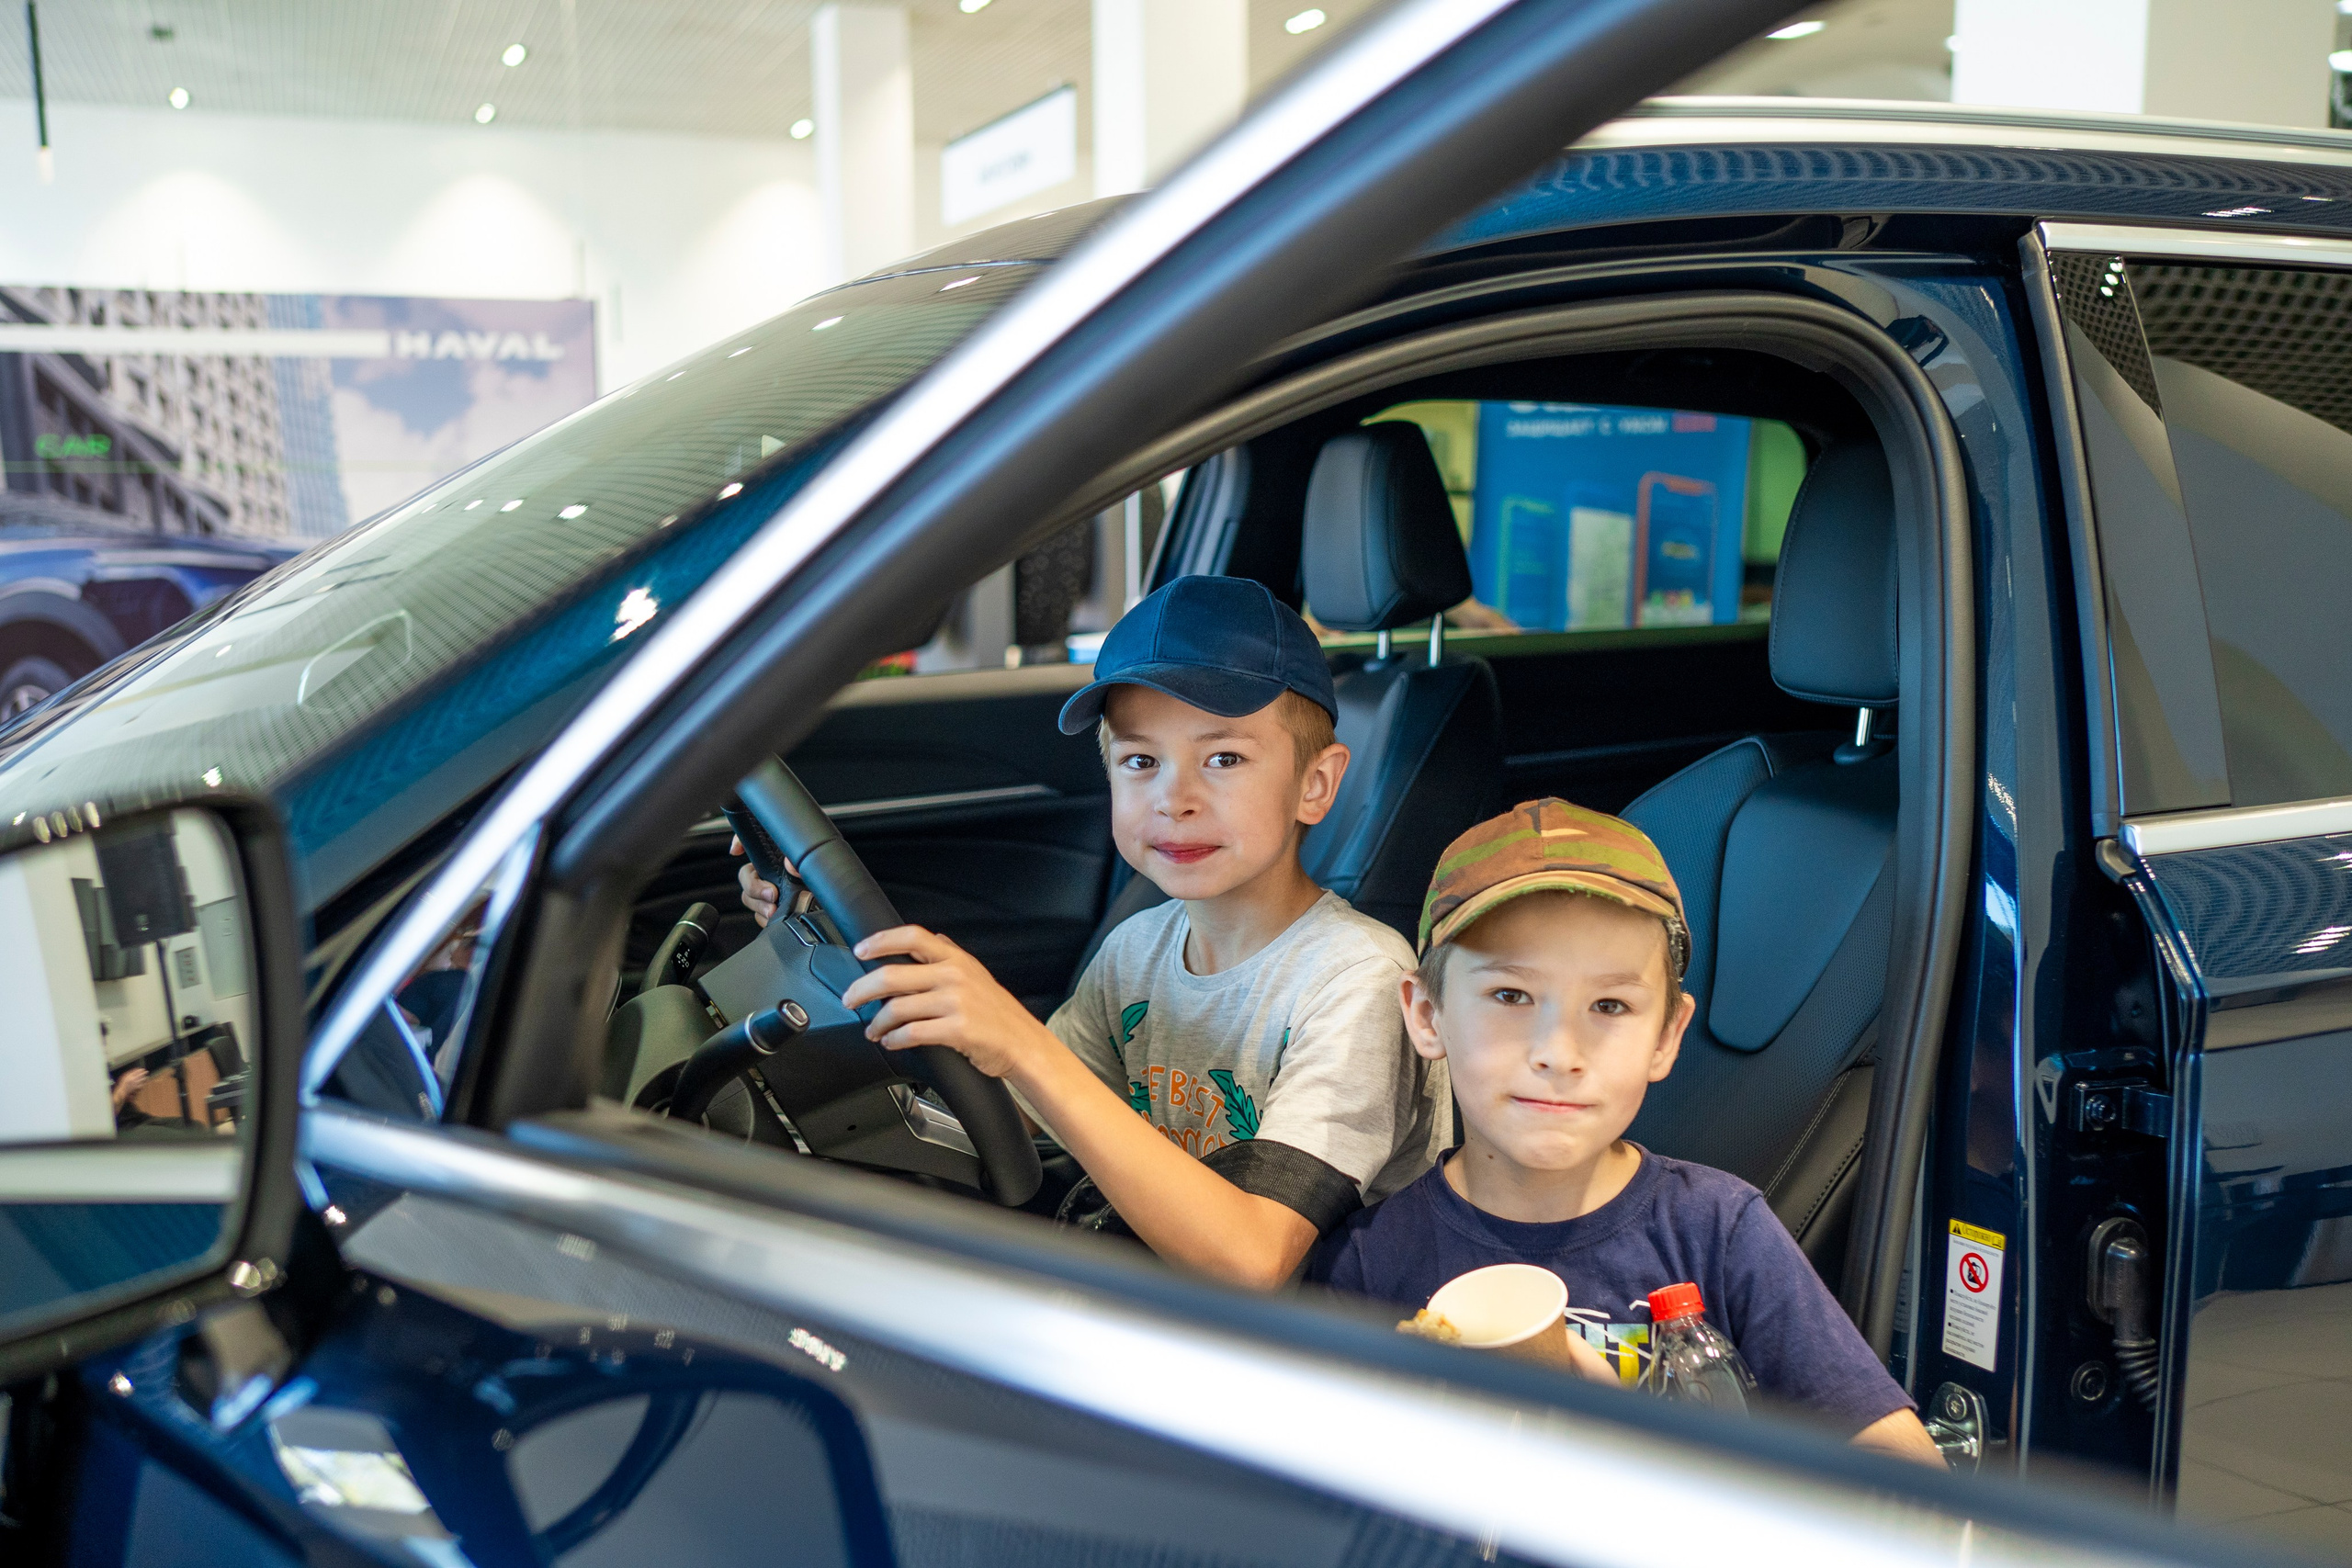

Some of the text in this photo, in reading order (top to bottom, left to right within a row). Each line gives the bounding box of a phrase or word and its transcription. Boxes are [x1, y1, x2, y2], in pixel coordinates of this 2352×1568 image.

[396, 329, 565, 361] HAVAL
[35, 433, 111, 459] CAR
[1169, 1068, 1226, 1129] BEST
